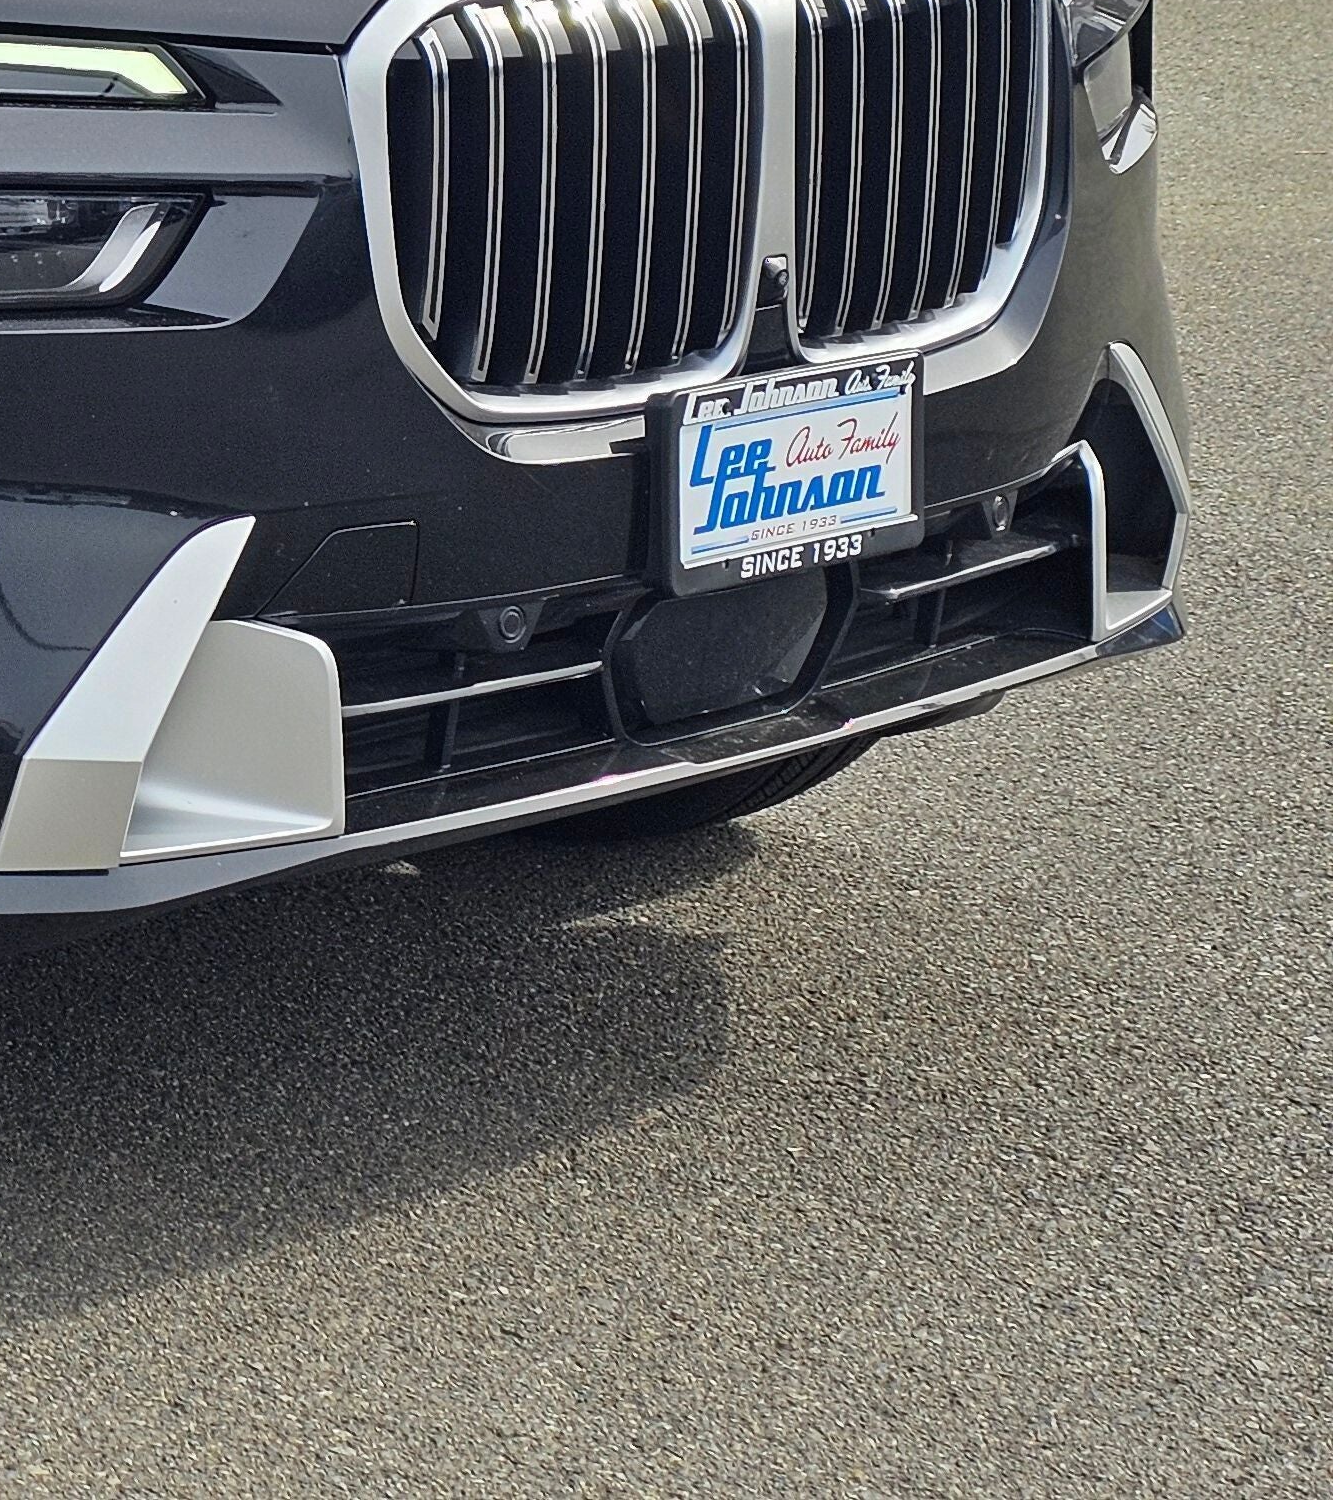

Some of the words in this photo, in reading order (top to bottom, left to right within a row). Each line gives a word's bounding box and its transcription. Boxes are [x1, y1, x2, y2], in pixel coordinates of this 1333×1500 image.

[734, 378, 839, 415] Johnson
[690, 425, 776, 487] Lee
[786, 426, 833, 467] Auto
[837, 412, 901, 463] Family
[694, 464, 886, 535] Johnson
[751, 523, 795, 541] SINCE
[801, 515, 837, 531] 1933
[740, 547, 803, 579] SINCE
[812, 534, 863, 565] 1933
